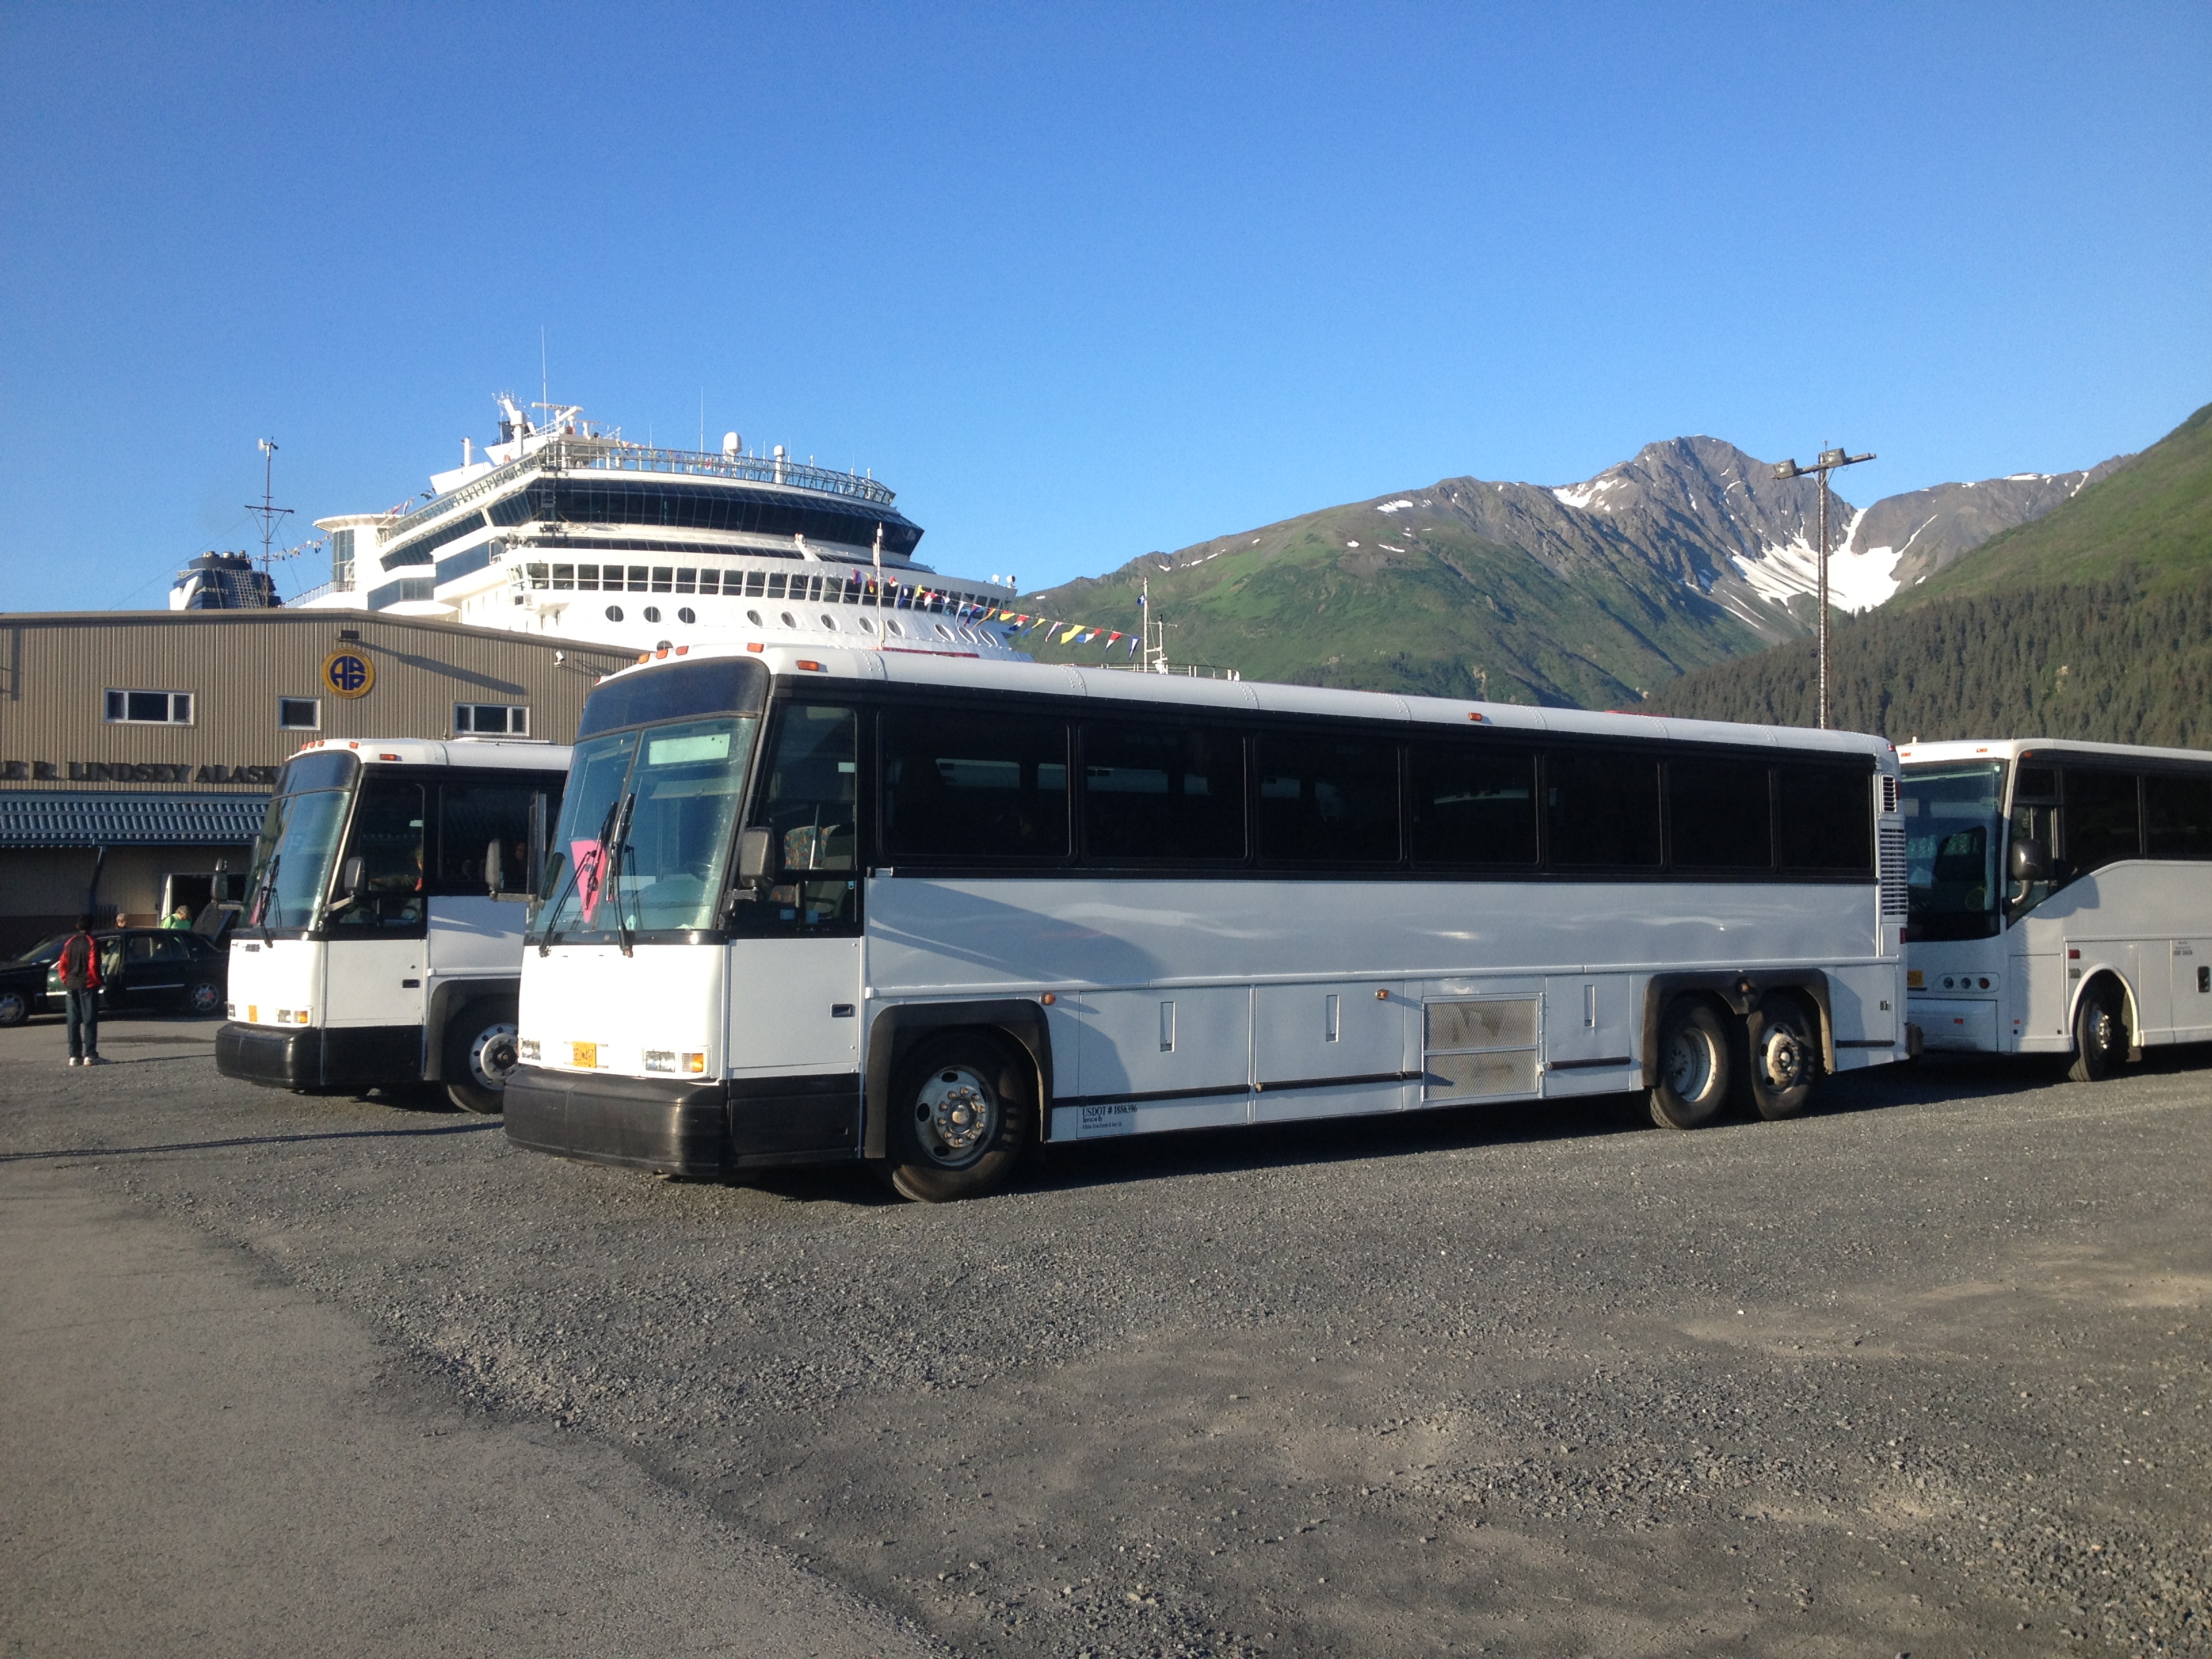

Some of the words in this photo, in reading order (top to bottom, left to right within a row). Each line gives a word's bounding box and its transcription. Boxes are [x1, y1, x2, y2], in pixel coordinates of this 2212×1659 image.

[66, 762, 193, 783] LINDSEY
[1082, 1106, 1106, 1117] USDOT
[1107, 1105, 1113, 1115] #
